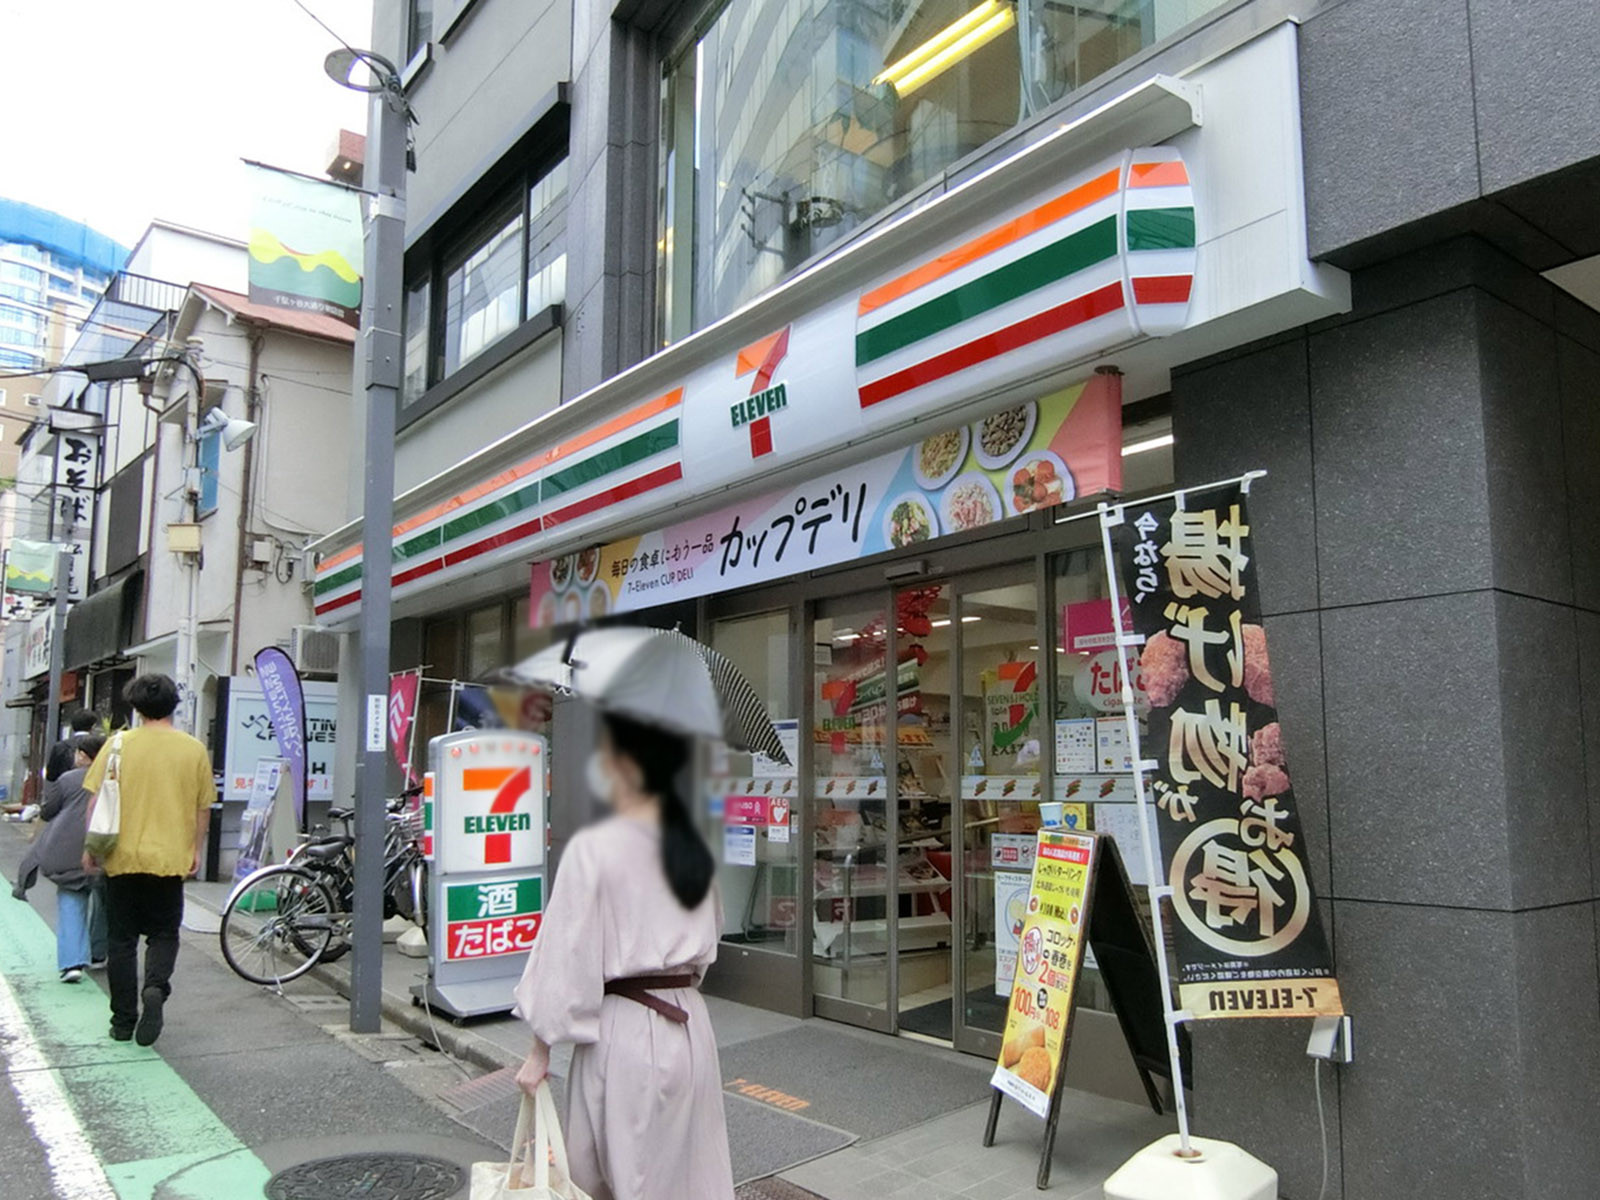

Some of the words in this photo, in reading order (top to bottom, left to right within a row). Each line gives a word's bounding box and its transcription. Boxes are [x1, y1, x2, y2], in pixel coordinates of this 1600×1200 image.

[720, 482, 866, 577] カップデリ
[611, 533, 714, 579] 毎日の食卓にもう一品
[660, 571, 676, 586] CUP
[677, 567, 694, 582] DELI
[770, 798, 788, 806] AED
[477, 882, 518, 918] 酒
[454, 919, 537, 958] たばこ
